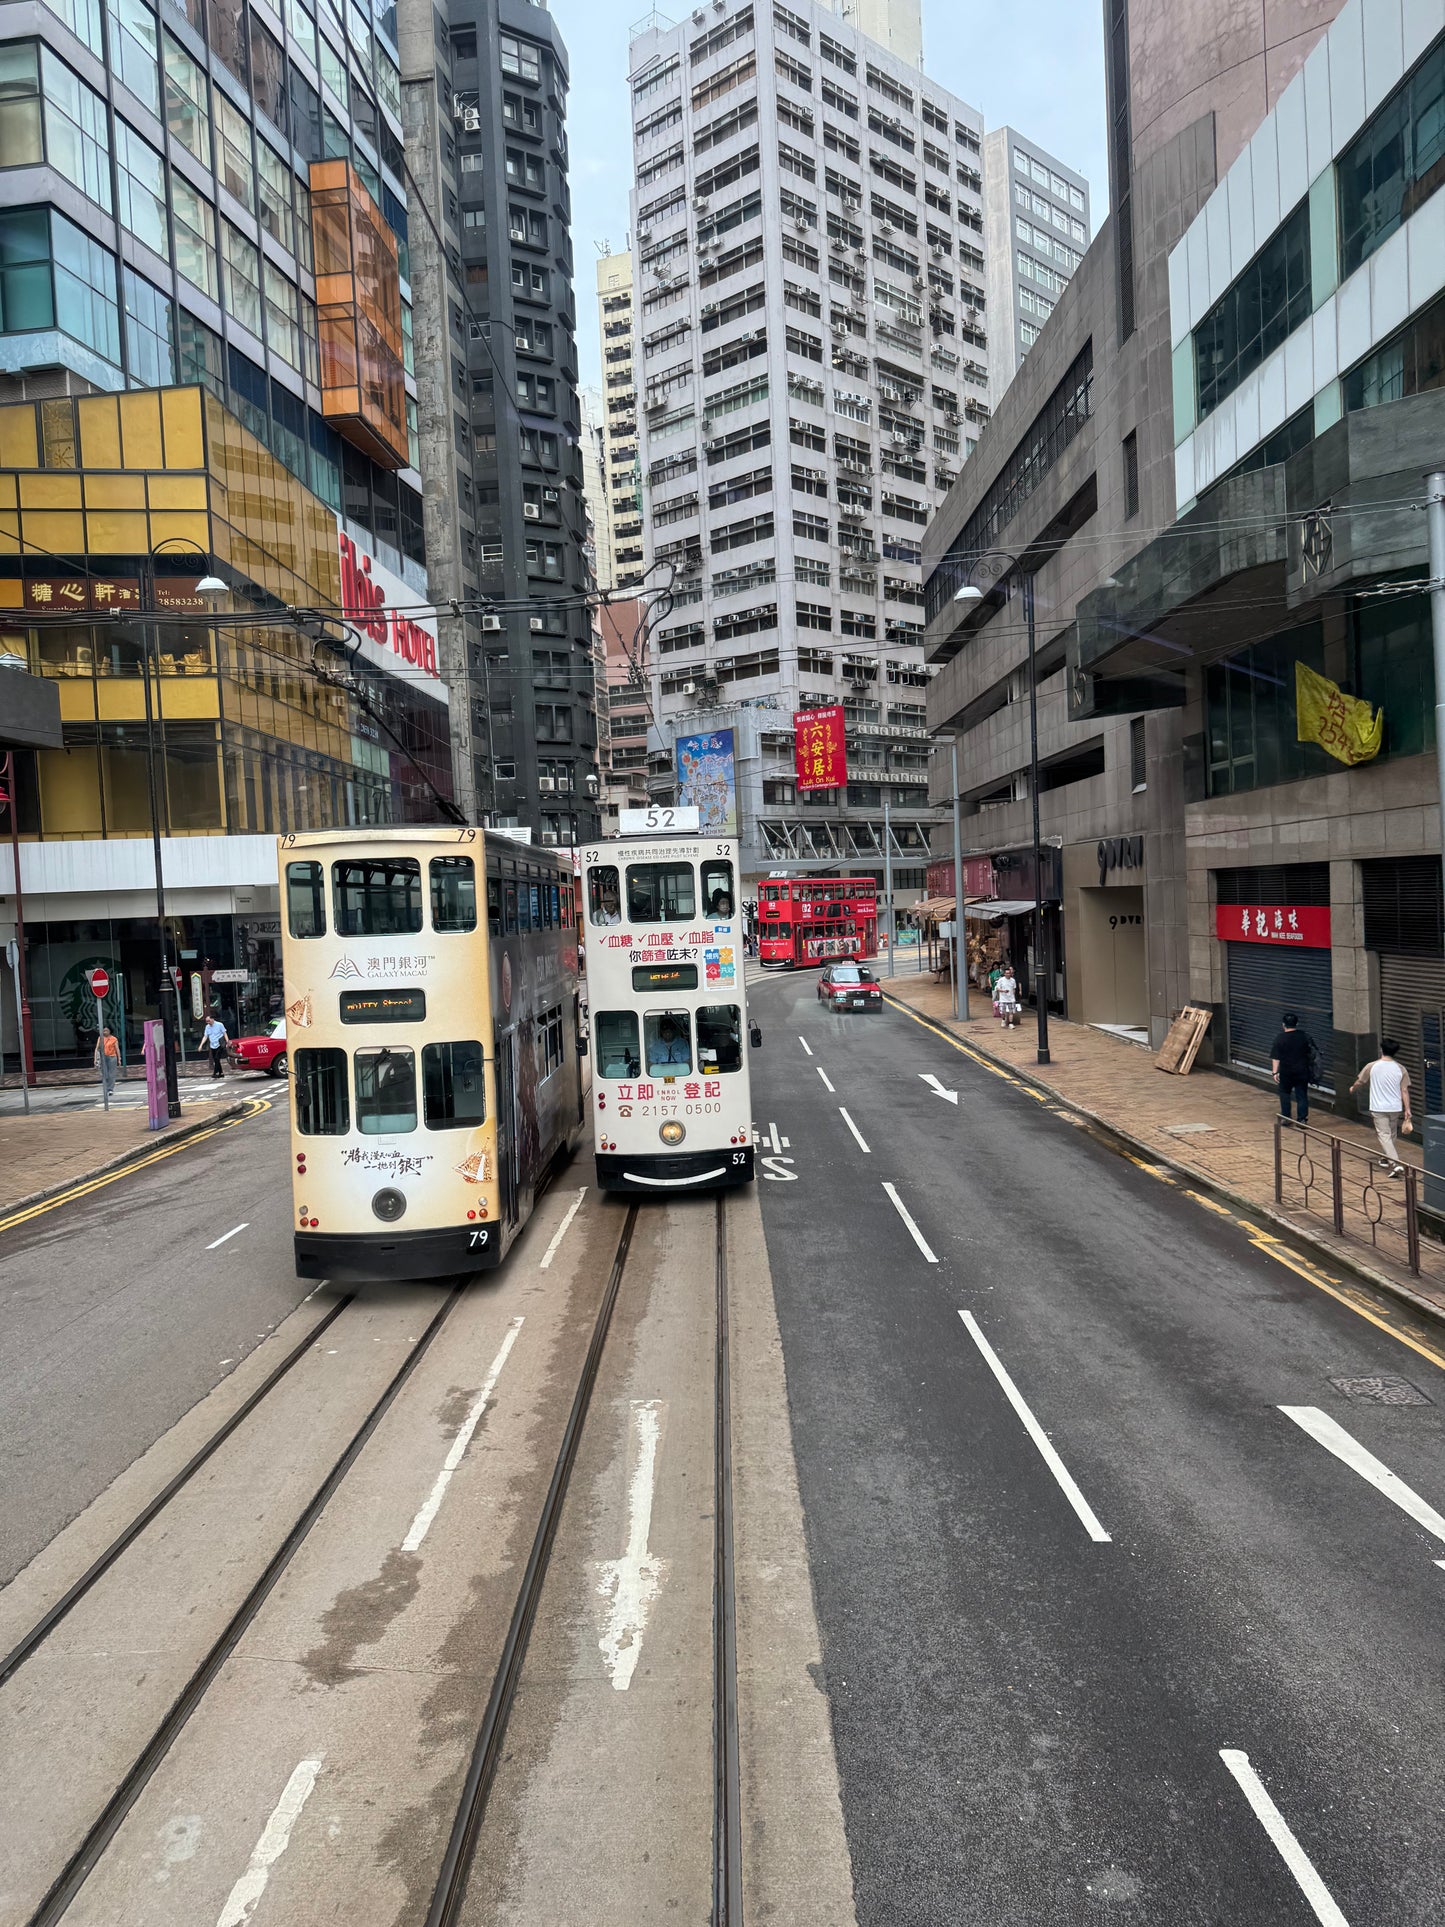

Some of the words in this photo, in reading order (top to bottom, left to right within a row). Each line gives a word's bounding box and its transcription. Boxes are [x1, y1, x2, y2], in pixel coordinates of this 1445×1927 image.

[31, 583, 141, 602] 糖心軒酒
[340, 533, 388, 645] ibis
[392, 609, 441, 679] HOTEL
[810, 721, 825, 776] 六安居
[645, 809, 675, 828] 52
[281, 834, 296, 849] 79
[457, 829, 476, 843] 79
[585, 851, 599, 862] 52
[716, 845, 730, 856] 52
[608, 935, 633, 948] 血糖
[647, 932, 674, 946] 血壓
[688, 931, 715, 944] 血脂
[367, 955, 427, 970] 澳門銀河
[617, 1083, 654, 1100] 立即
[684, 1081, 721, 1099] 登記
[642, 1105, 678, 1116] 2157
[685, 1103, 721, 1115] 0500
[732, 1153, 746, 1165] 52
[469, 1230, 489, 1247] 79
